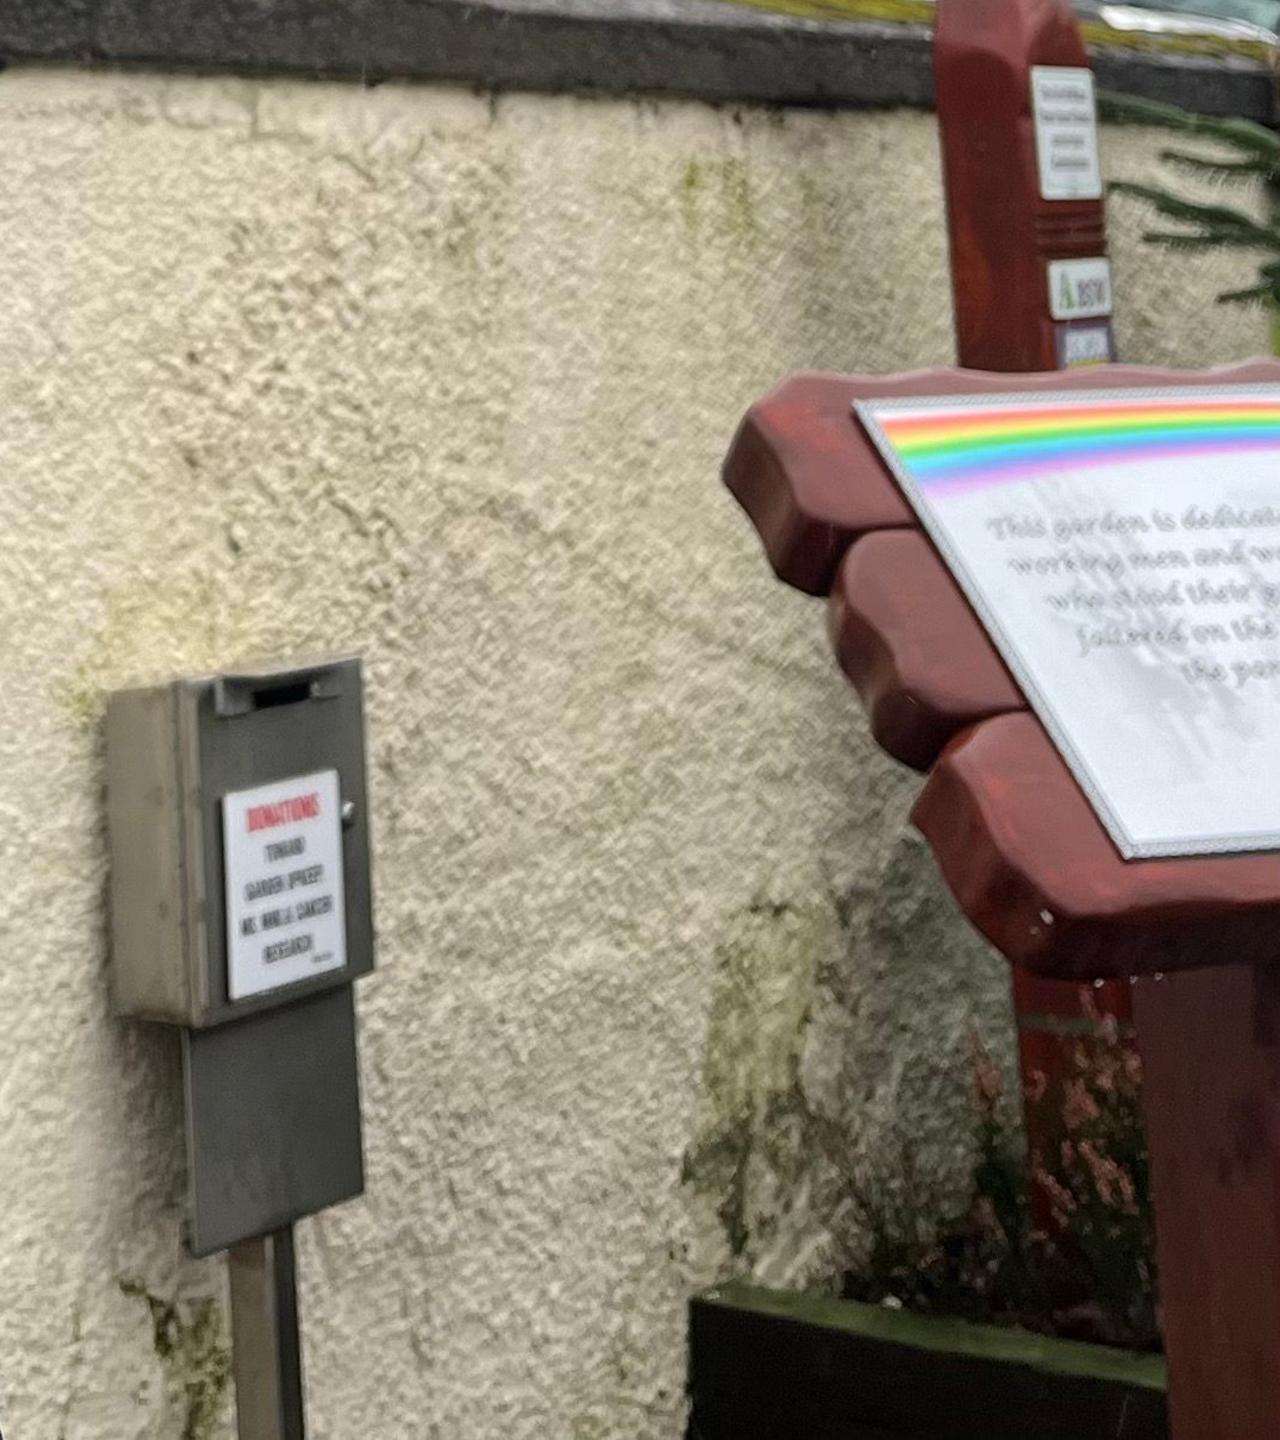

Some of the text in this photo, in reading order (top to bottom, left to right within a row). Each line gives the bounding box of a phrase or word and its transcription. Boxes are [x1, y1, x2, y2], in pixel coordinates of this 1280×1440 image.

[986, 514, 1047, 541] This
[1053, 509, 1151, 543] garden
[246, 791, 320, 833] DONATIONS
